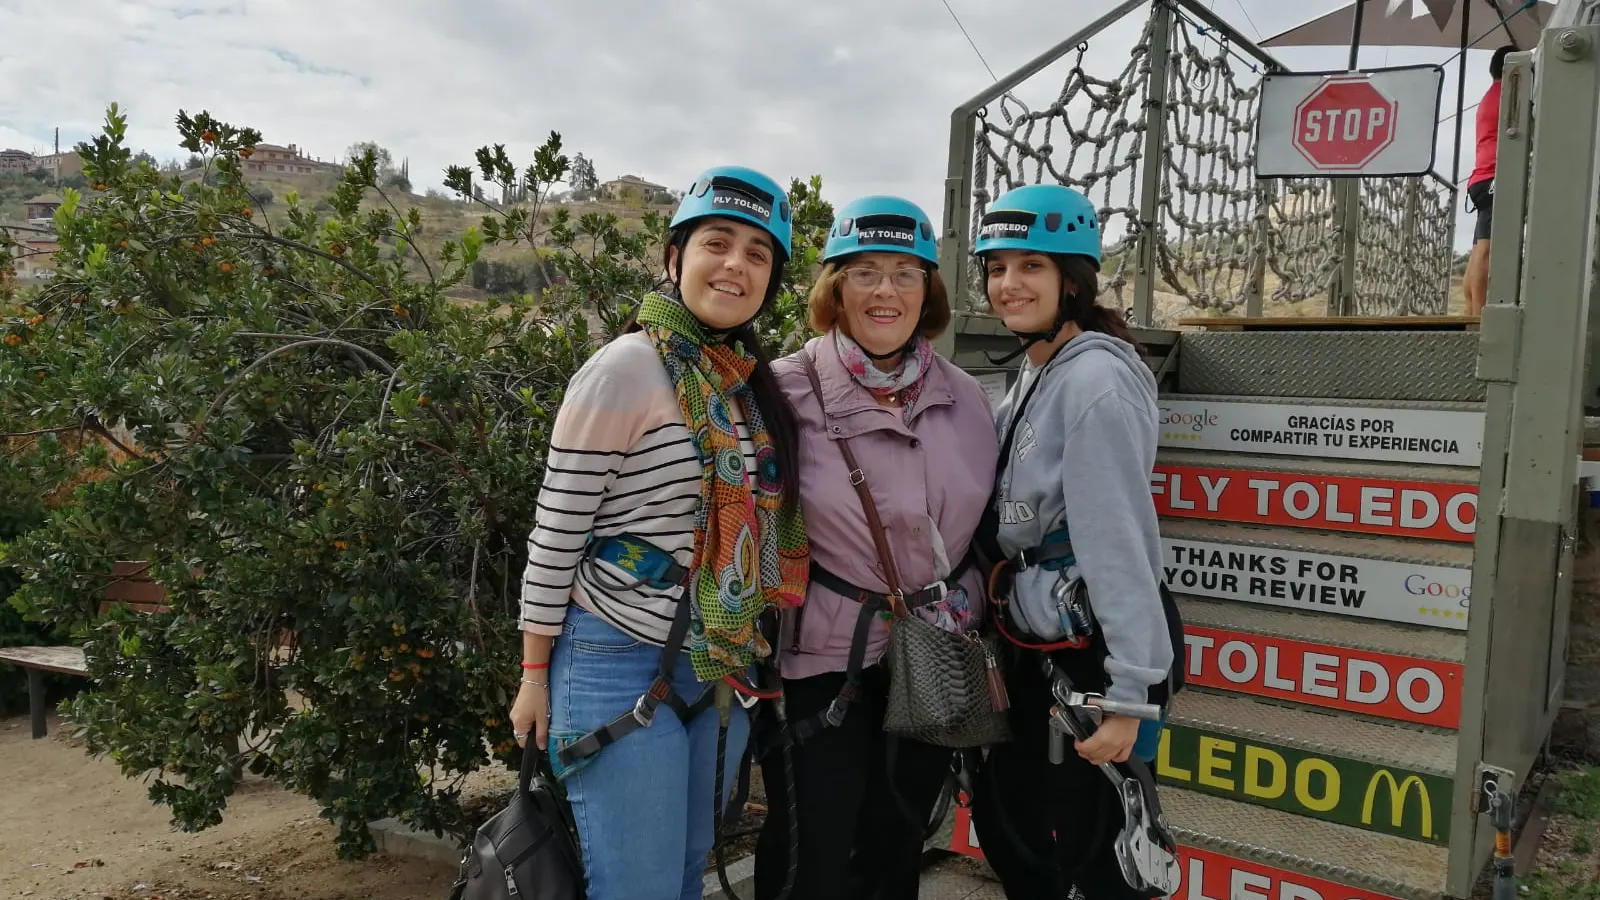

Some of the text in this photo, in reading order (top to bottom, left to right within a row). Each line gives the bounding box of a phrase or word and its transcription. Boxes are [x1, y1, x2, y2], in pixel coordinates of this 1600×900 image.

[1304, 108, 1386, 142] STOP
[712, 196, 770, 218] FLY TOLEDO
[859, 230, 914, 241] FLY TOLEDO
[1158, 407, 1219, 432] Google
[1360, 418, 1394, 433] POR
[1230, 428, 1318, 446] COMPARTIR
[1323, 433, 1344, 447] TU
[1348, 434, 1460, 454] EXPERIENCIA
[1248, 479, 1479, 534] TOLEDO
[1171, 545, 1359, 584] THANKS FOR
[1163, 566, 1367, 609] YOUR REVIEW
[1404, 574, 1471, 608] Goog
[1183, 634, 1444, 714] TOLEDO
[1157, 728, 1341, 812] LEDO
